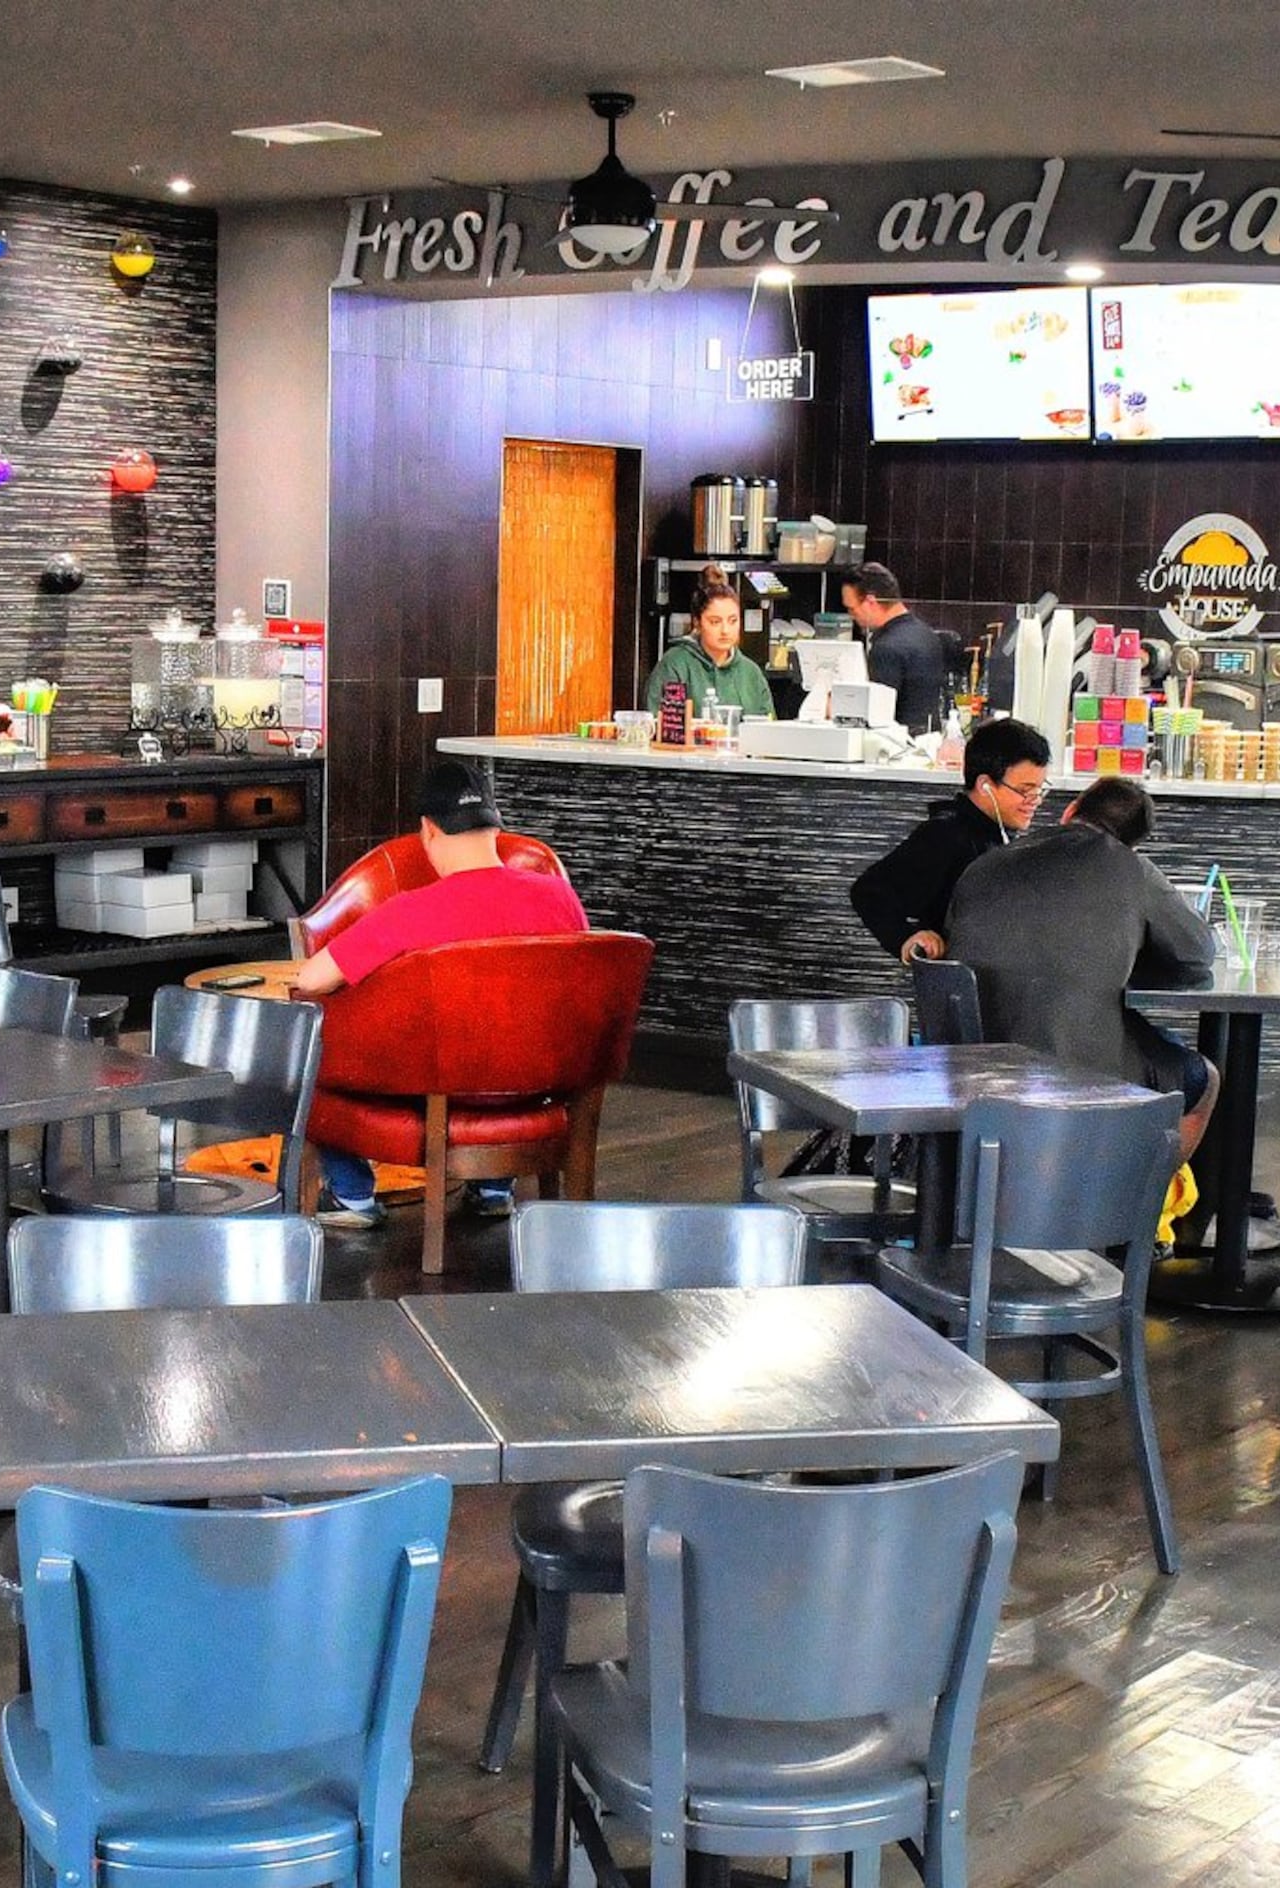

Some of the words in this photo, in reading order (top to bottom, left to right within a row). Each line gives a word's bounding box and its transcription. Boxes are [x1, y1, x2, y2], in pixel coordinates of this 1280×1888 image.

[329, 187, 525, 288] Fresh
[877, 156, 1065, 266] and
[738, 357, 803, 380] ORDER
[745, 379, 795, 400] HERE
[1148, 551, 1278, 598] Empanada
[1177, 598, 1246, 619] HOUSE
